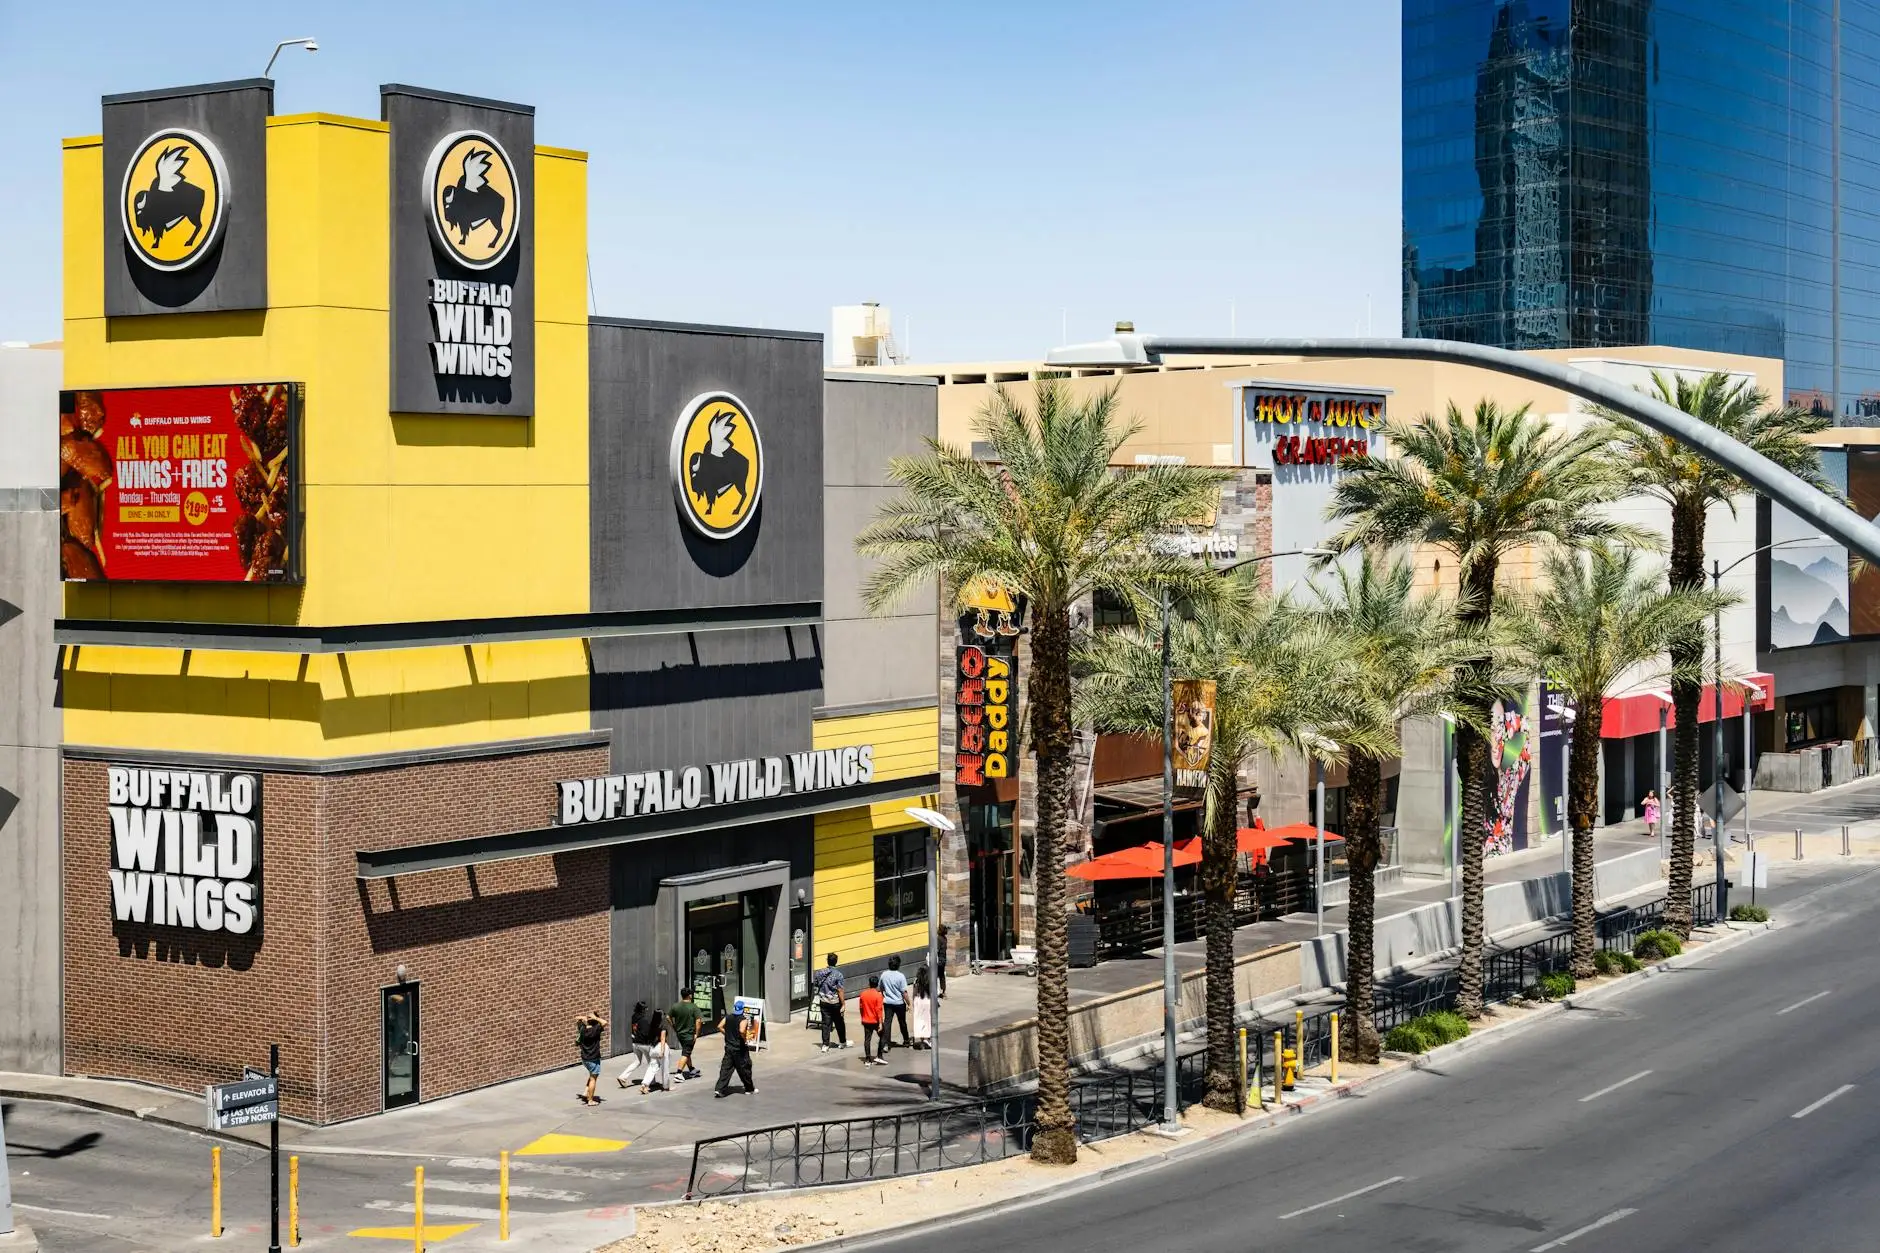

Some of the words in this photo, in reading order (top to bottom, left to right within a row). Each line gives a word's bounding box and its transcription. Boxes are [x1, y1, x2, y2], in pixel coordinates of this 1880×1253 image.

[432, 279, 513, 308] BUFFALO
[432, 303, 513, 346] WILD
[432, 342, 513, 378] WINGS
[144, 417, 172, 426] BUFFALO
[173, 416, 190, 425] WILD
[190, 415, 212, 425] WINGS
[1255, 395, 1306, 424] HOT
[1323, 399, 1383, 429] JUICY
[116, 436, 139, 460] ALL
[142, 435, 169, 459] YOU
[172, 434, 200, 459] CAN
[203, 433, 228, 459] EAT
[119, 492, 144, 506] Monday
[150, 491, 181, 506] Thursday
[985, 656, 1010, 778] Daddy
[107, 767, 253, 814] BUFFALO
[560, 766, 702, 825] BUFFALO
[709, 757, 783, 805] WILD
[789, 745, 874, 793] WINGS
[107, 806, 253, 880] WILD
[107, 870, 253, 934] WINGS
[793, 981, 806, 994] OUT
[231, 1087, 267, 1101] ELEVATOR
[230, 1109, 244, 1118] LAS
[244, 1104, 269, 1116] VEGAS
[230, 1115, 250, 1125] STRIP
[250, 1111, 277, 1122] NORTH
